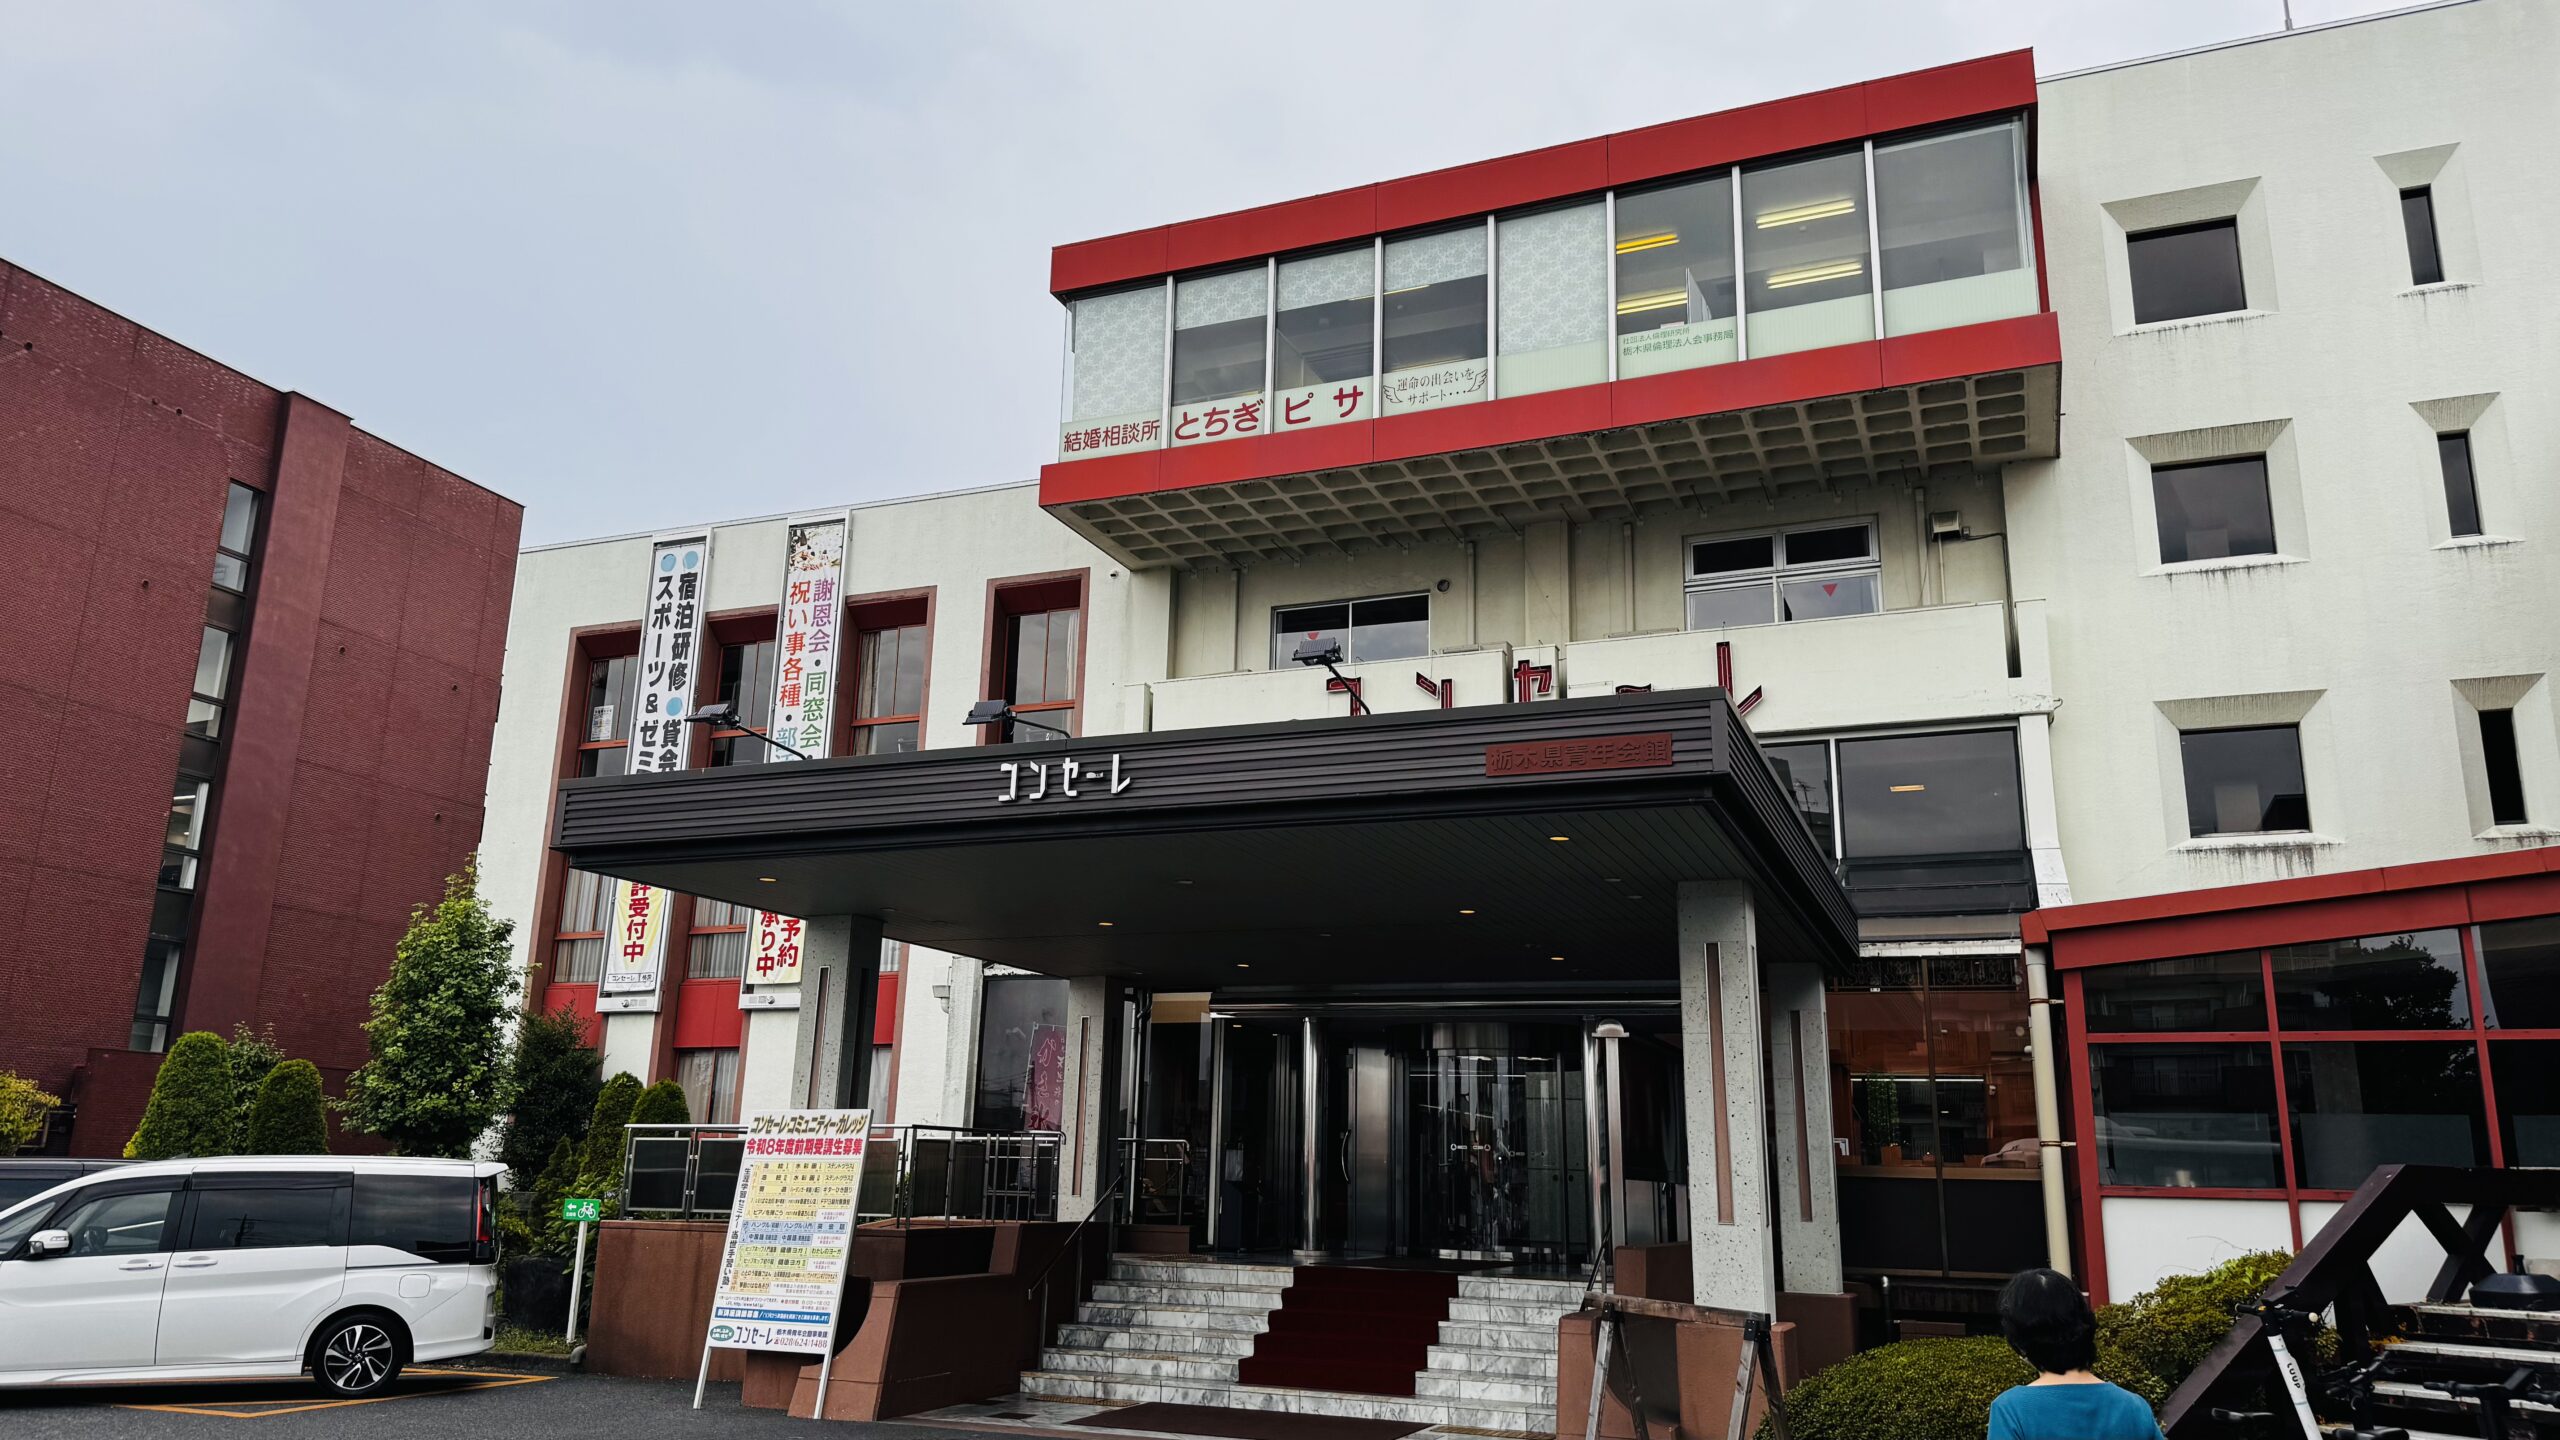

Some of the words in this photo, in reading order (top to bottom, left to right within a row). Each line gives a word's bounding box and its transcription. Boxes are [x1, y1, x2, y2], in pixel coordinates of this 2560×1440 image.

[1623, 329, 1734, 356] 栃木県倫理法人会事務局
[1397, 368, 1475, 392] 運命の出会いを
[1063, 419, 1161, 453] 結婚相談所
[1174, 398, 1264, 440] とちぎ
[667, 571, 698, 693] 宿泊研修
[1491, 740, 1669, 771] 栃木県青年会館
[998, 754, 1131, 802] コンセーレ
[776, 918, 801, 968] 予約
[747, 1138, 863, 1156] 令和8年度前期受講生募集
[733, 1326, 773, 1345] コンセーレ
[2287, 1362, 2301, 1389] LUUP
